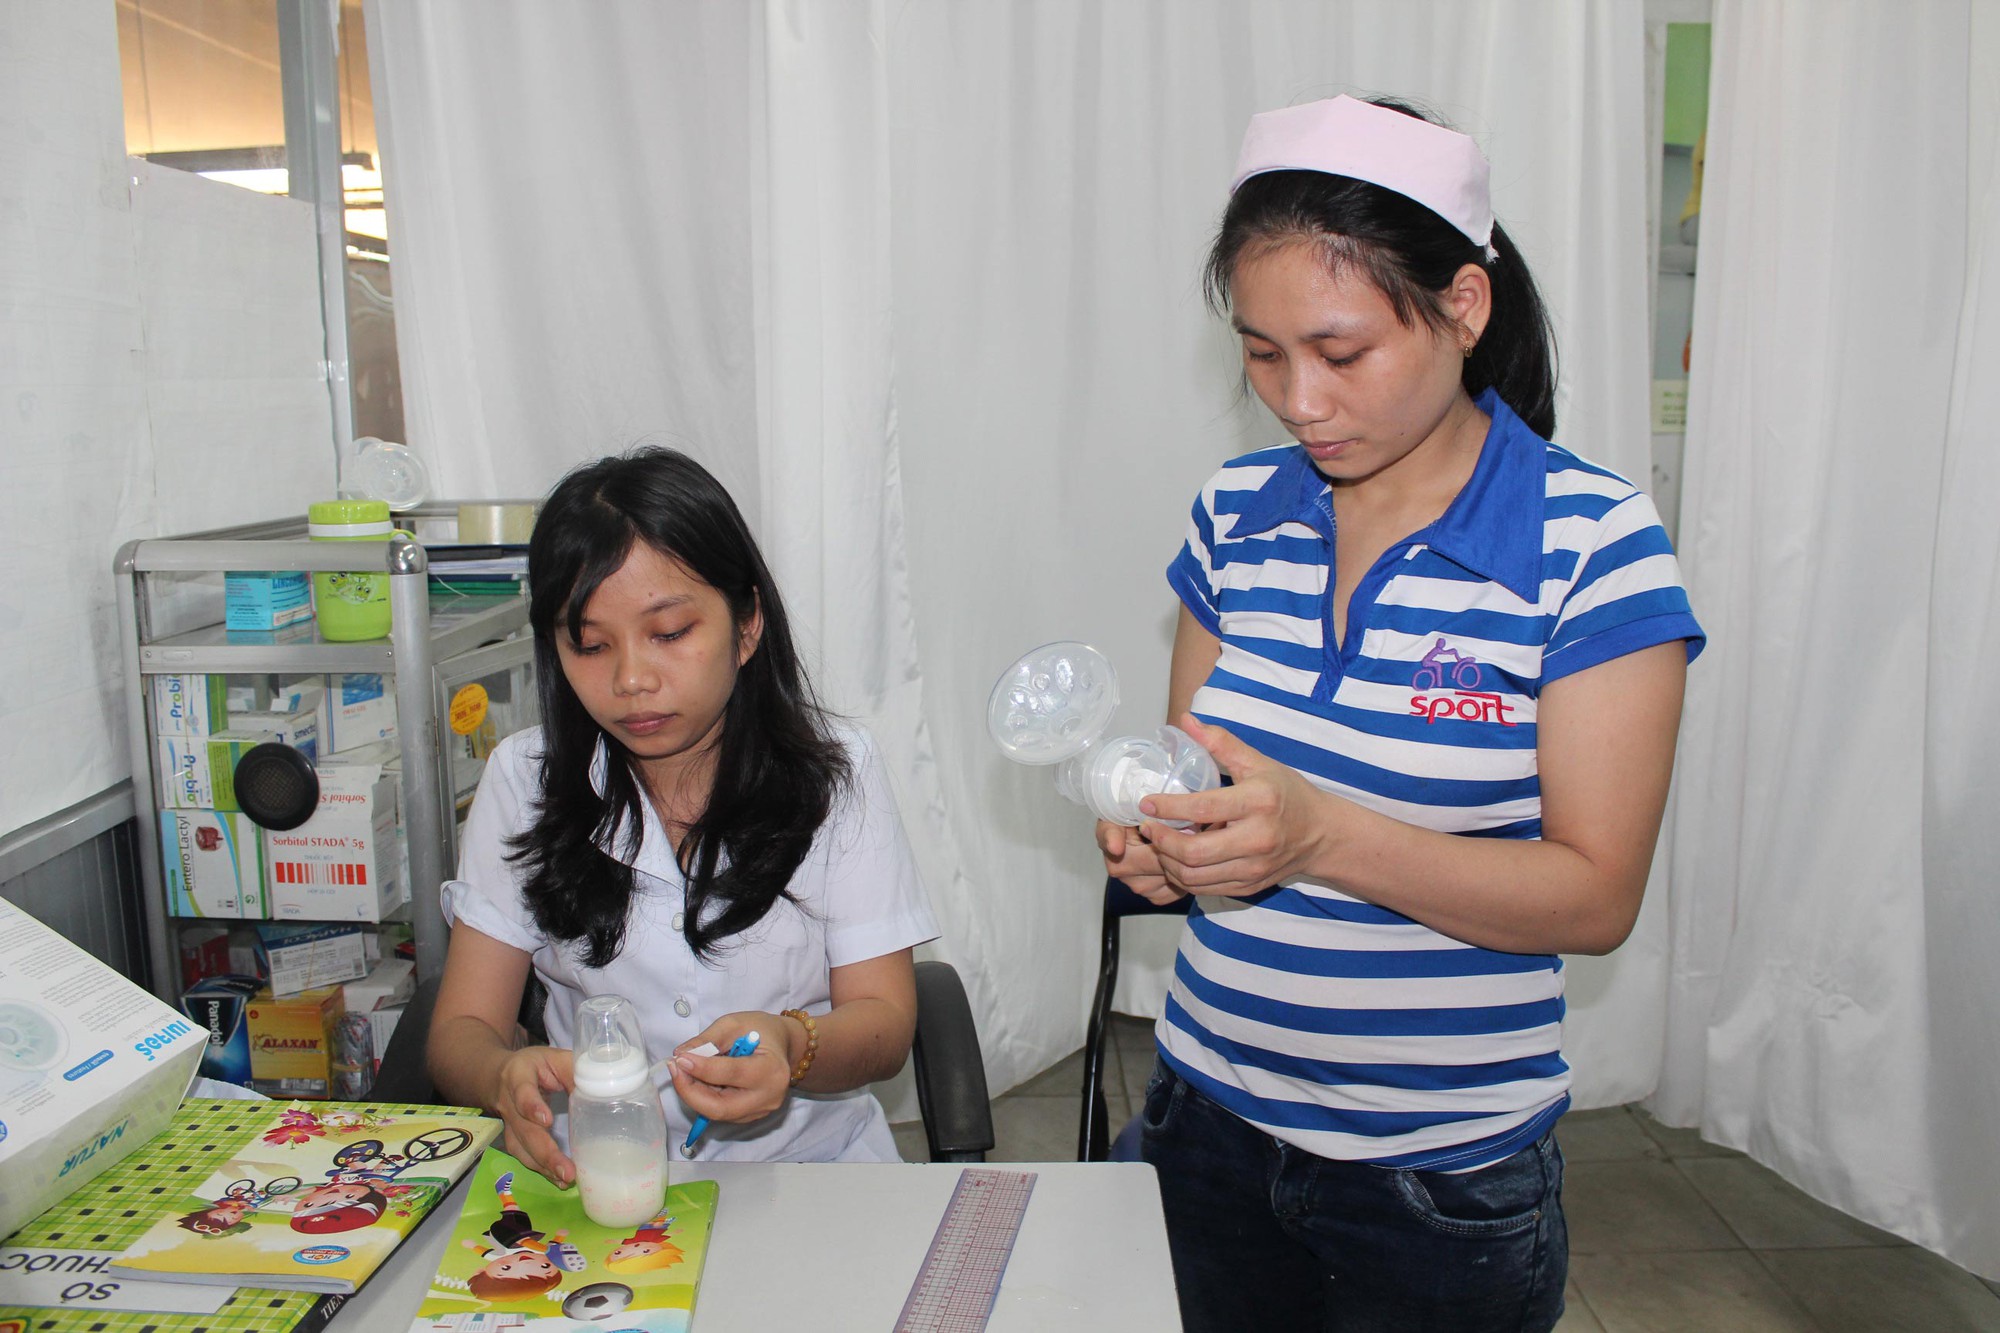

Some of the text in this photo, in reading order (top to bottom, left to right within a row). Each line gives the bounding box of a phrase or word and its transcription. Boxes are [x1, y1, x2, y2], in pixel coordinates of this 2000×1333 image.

[1410, 691, 1518, 727] sport
[183, 755, 199, 802] Probio
[176, 816, 193, 892] Entero Lactyl
[273, 836, 308, 846] Sorbitol
[353, 839, 365, 850] 5g
[208, 1001, 224, 1046] Panadol
[262, 1038, 319, 1049] ALAXAN
[58, 1120, 129, 1178] NATUR
